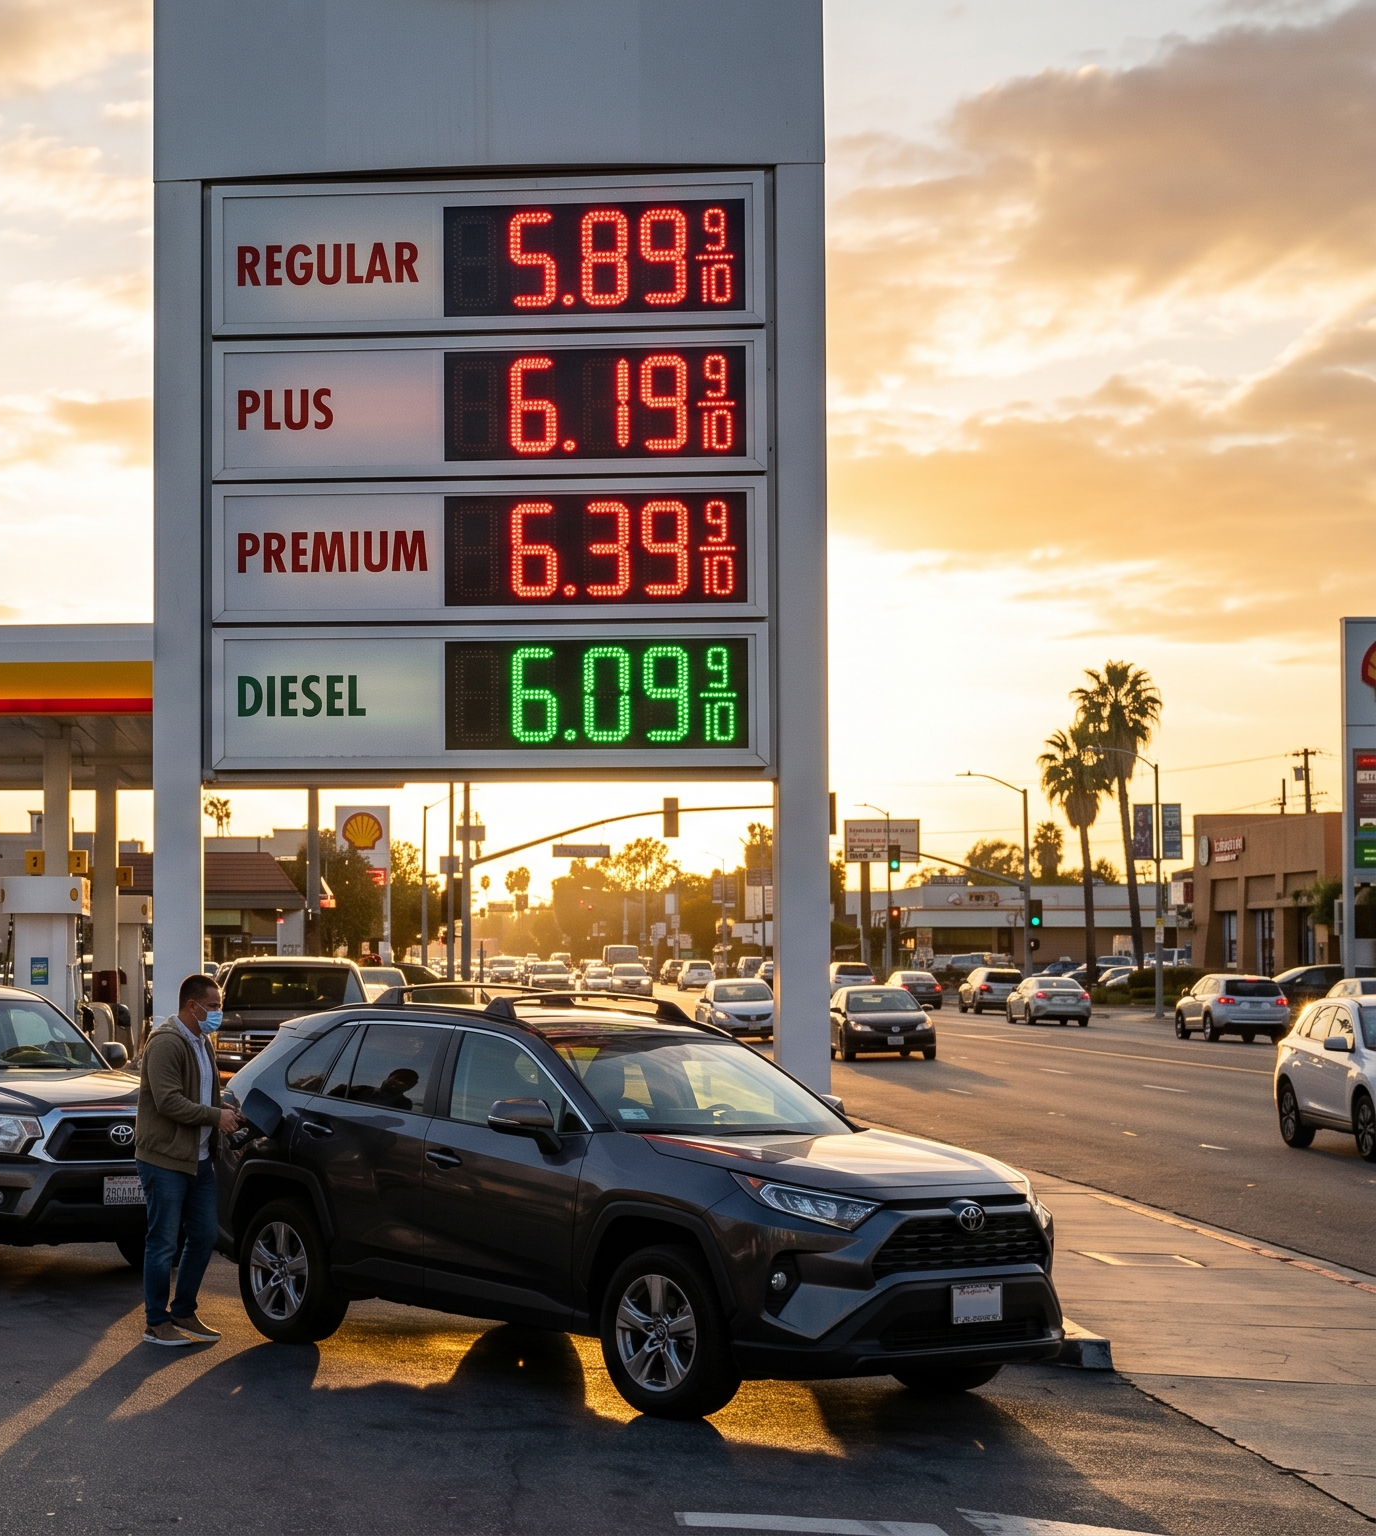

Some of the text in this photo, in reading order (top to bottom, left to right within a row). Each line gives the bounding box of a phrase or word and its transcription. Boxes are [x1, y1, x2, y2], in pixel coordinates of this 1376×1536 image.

[237, 209, 687, 306] REGULAR 5.89
[237, 355, 688, 453] PLUS 6.19
[237, 500, 689, 598] PREMIUM 6.39
[237, 646, 690, 743] DIESEL 6.09
